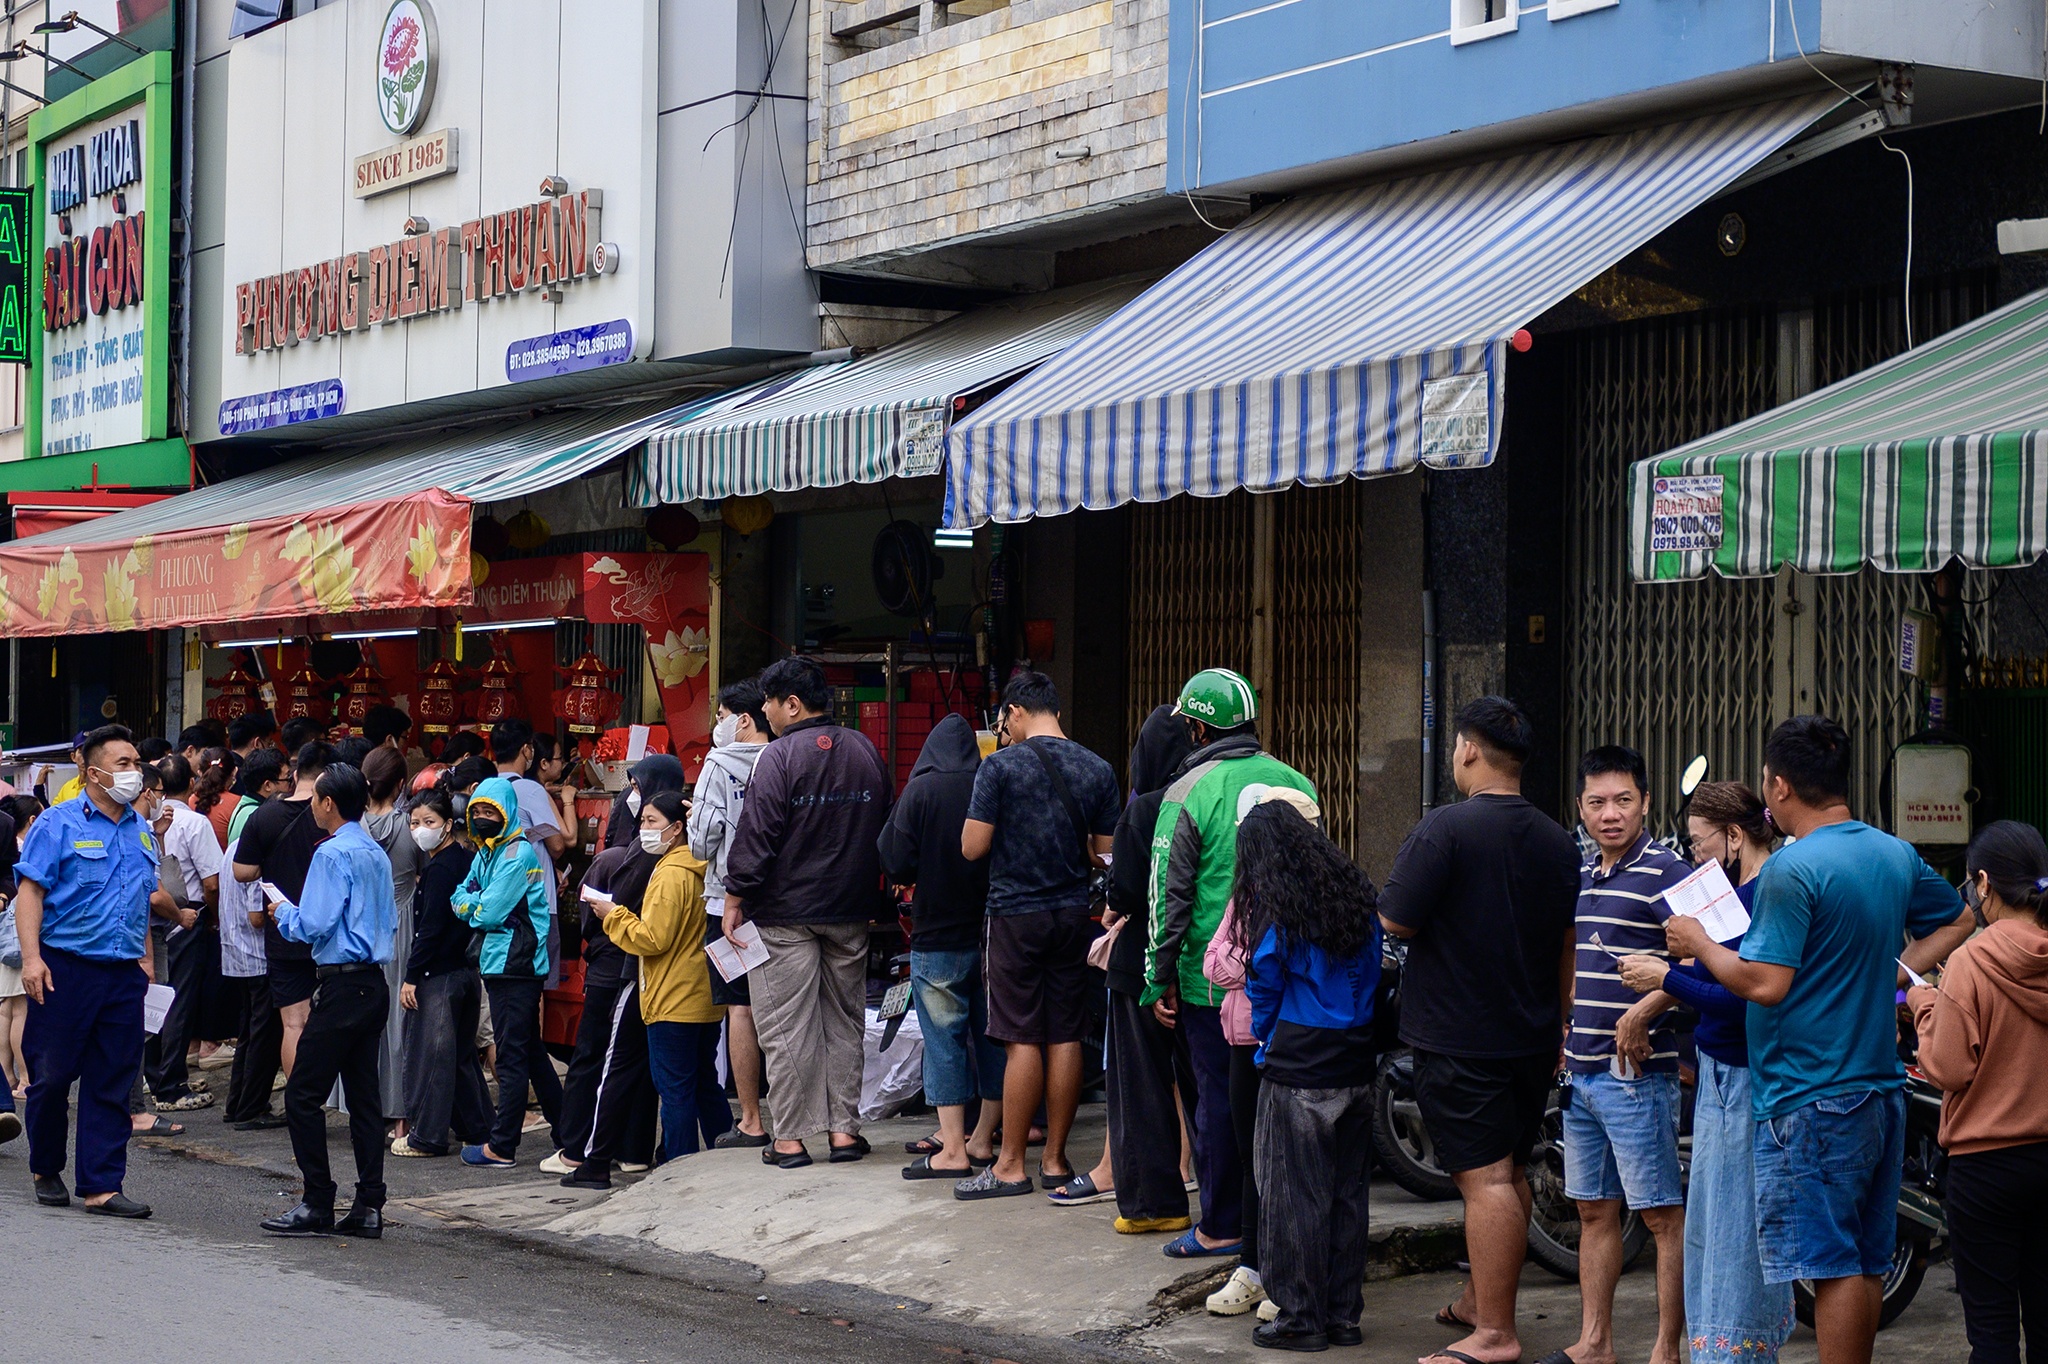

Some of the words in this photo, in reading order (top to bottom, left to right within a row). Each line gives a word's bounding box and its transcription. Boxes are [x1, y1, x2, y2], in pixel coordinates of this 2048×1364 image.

[51, 145, 84, 214] NHA
[90, 120, 138, 197] KHOA
[356, 152, 401, 190] SINCE
[407, 138, 444, 173] 1985
[89, 194, 144, 315] GÒN
[235, 252, 362, 356] PHƯƠNG
[461, 176, 594, 302] THUẬN
[510, 353, 521, 370] ĐT:
[1655, 494, 1693, 515] HOÀNG
[1697, 496, 1720, 513] NAM
[1654, 517, 1678, 535] 0907
[1681, 515, 1700, 534] 000
[1702, 515, 1720, 533] 875
[160, 553, 214, 589] PHƯƠNG
[1187, 697, 1216, 716] Grab
[1908, 804, 1929, 812] HCM
[1152, 834, 1171, 849] rab
